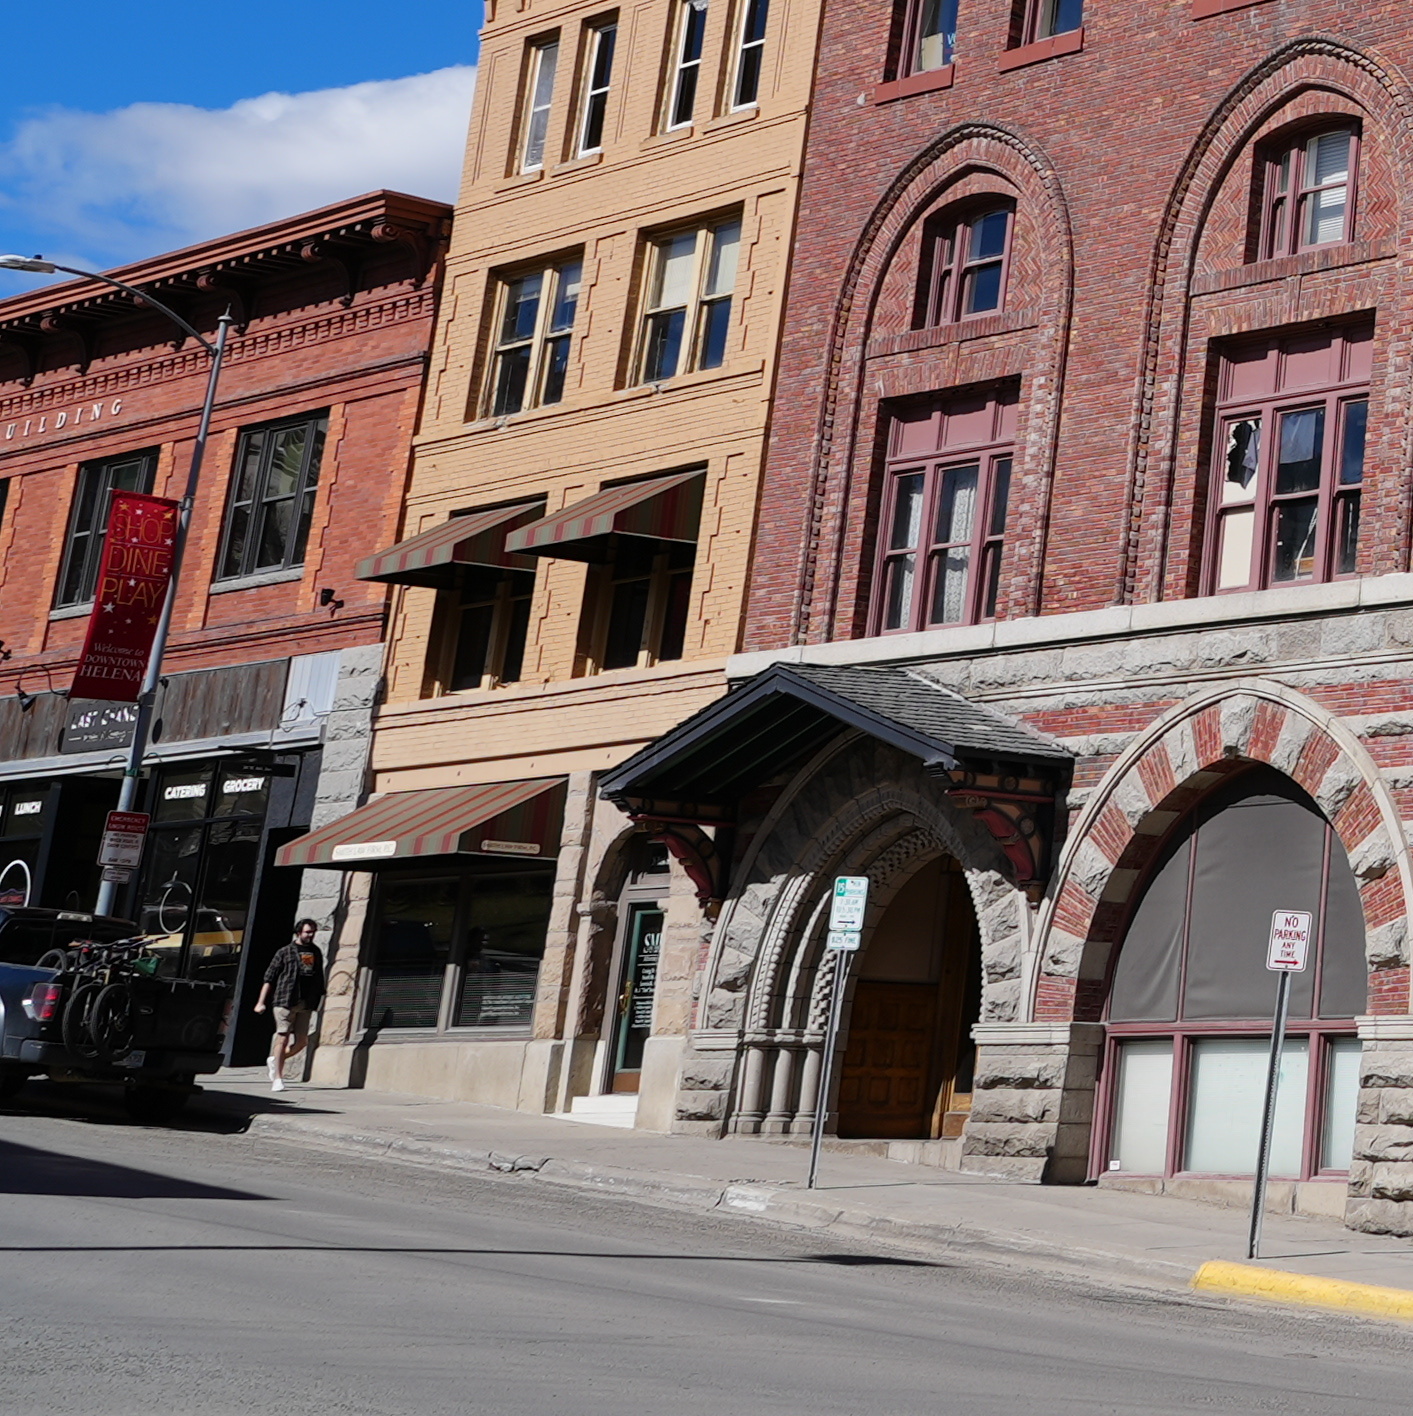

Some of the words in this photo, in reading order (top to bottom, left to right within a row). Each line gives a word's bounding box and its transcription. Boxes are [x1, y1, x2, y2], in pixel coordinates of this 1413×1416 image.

[5, 398, 123, 440] UILDING
[113, 513, 174, 544] SHOP
[107, 545, 169, 577] DINE
[99, 577, 165, 608] PLAY
[93, 642, 131, 656] Welcome
[134, 648, 144, 656] to
[84, 653, 147, 669] DOWNTOWN
[79, 665, 142, 682] HELENA
[164, 784, 206, 800] CATERING
[222, 777, 265, 793] GROCERY
[14, 800, 42, 816] LUNCH
[837, 882, 845, 893] 15
[1285, 917, 1298, 928] NO
[1274, 929, 1306, 941] PARKING
[1280, 950, 1295, 958] TIME
